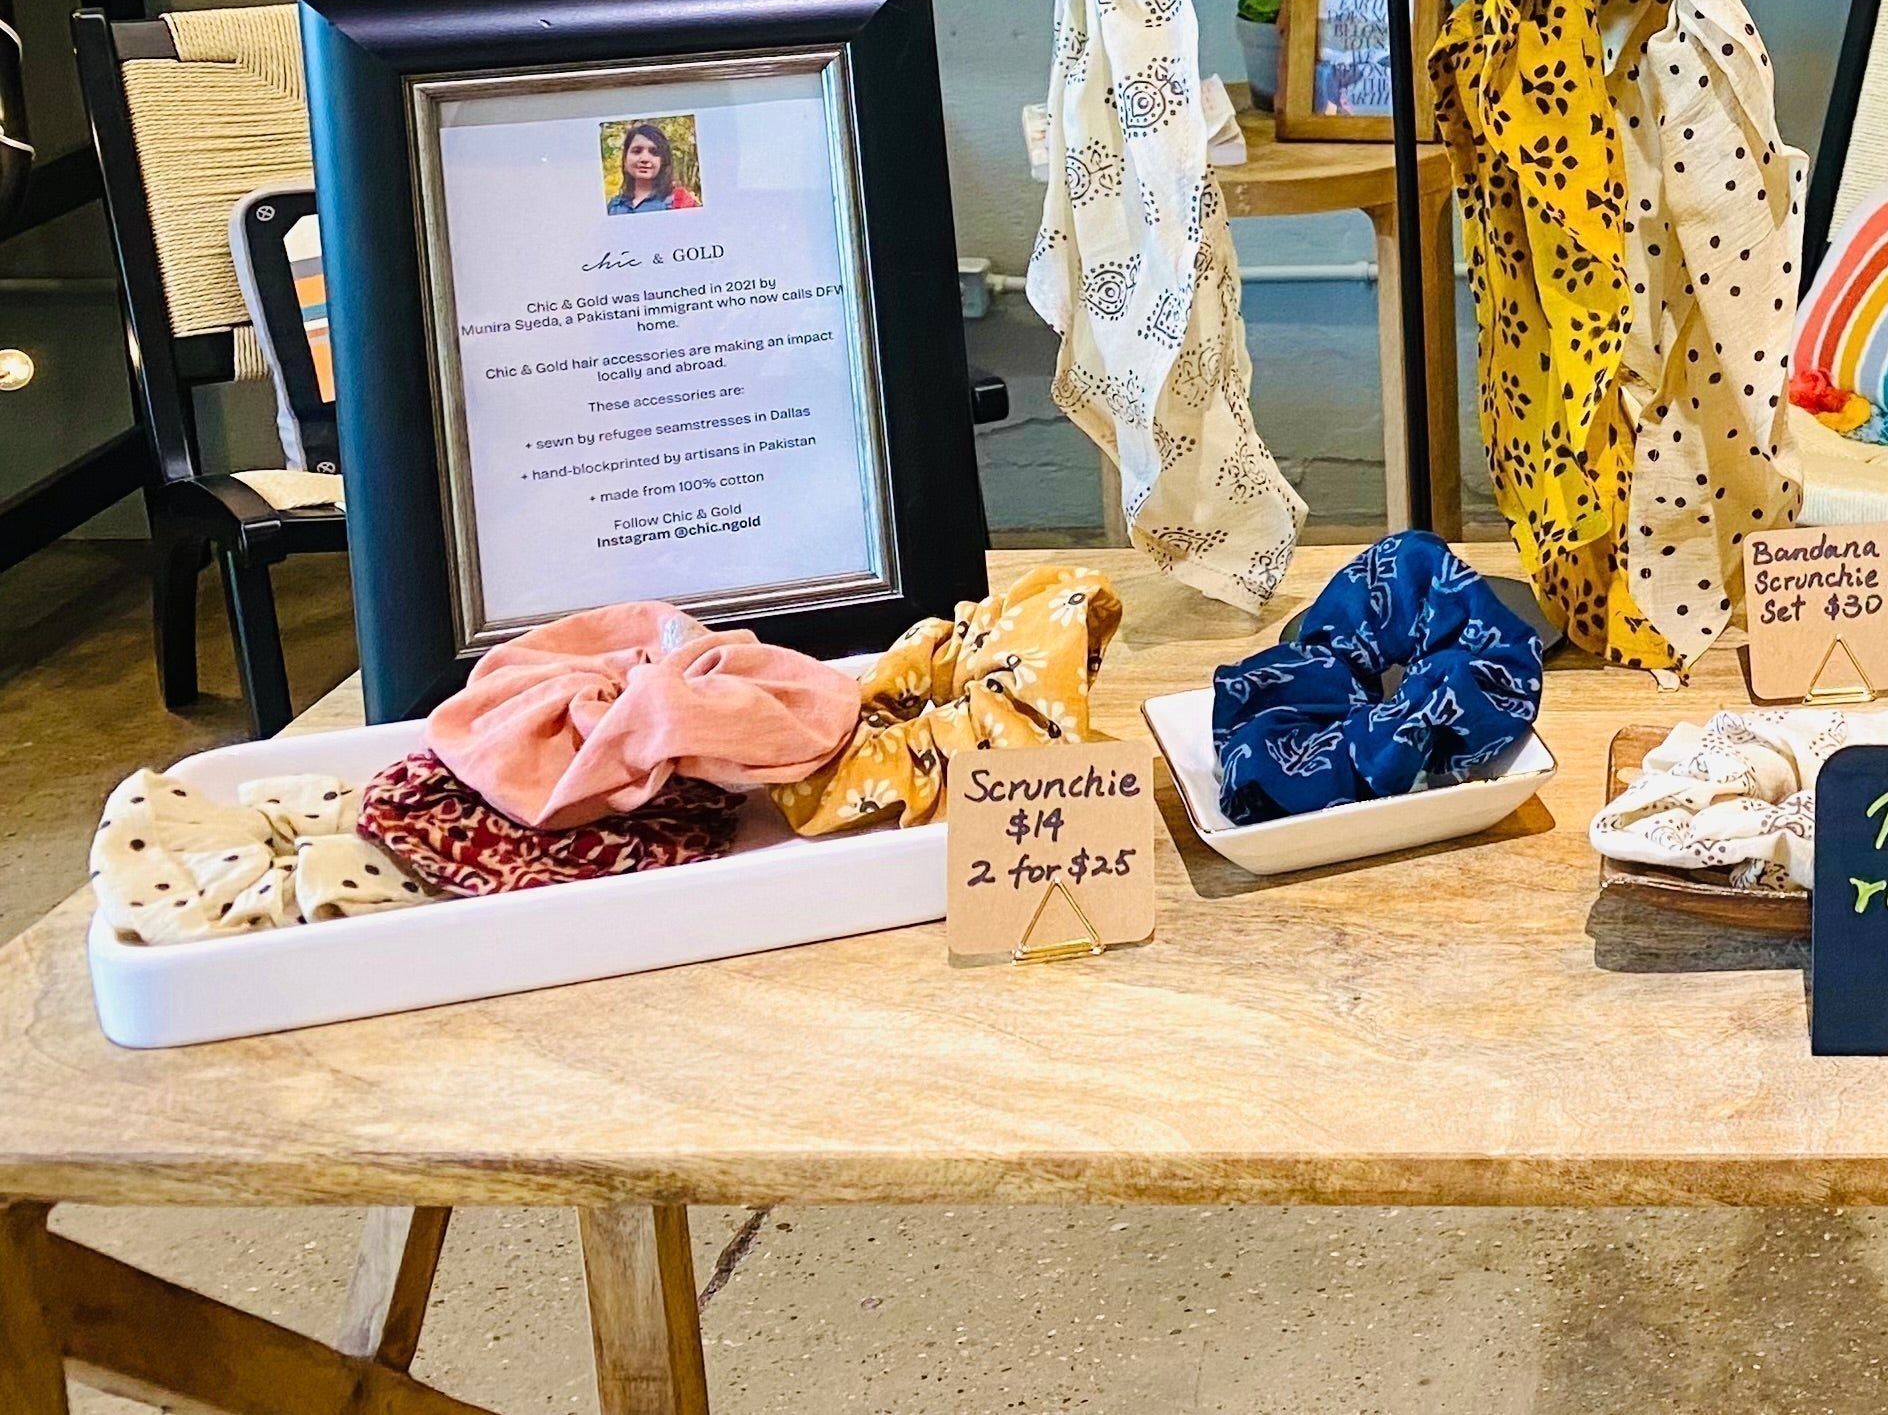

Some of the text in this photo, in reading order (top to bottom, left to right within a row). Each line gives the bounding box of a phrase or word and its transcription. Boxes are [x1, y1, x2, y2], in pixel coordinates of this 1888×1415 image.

[653, 253, 664, 264] &
[673, 245, 724, 262] GOLD
[461, 321, 511, 336] Munira
[515, 315, 562, 332] Syeda,
[565, 315, 574, 325] a
[577, 305, 640, 324] Pakistani
[643, 298, 714, 316] immigrant
[717, 295, 746, 308] who
[749, 292, 778, 304] now
[782, 288, 813, 301] calls
[527, 277, 776, 314] Chic & Gold was launched in 2021 by
[637, 318, 679, 332] home.
[485, 331, 834, 380] Chic & Gold hair accessories are making an impact
[597, 357, 727, 382] locally and abroad.
[588, 386, 745, 412] These accessories are:
[536, 407, 811, 450] sewn by refugee seamstresses in Dallas
[532, 435, 816, 481] hand-blockprinted by artisans in Pakistan
[600, 472, 764, 502] made from 100% cotton
[597, 515, 761, 548] Instagram @chic.ngold
[614, 503, 742, 531] Follow Chic & Gold
[1752, 533, 1881, 567] Bandana
[1755, 564, 1880, 595] Scrunchie
[1761, 593, 1883, 624] Set $30
[964, 765, 1141, 803] Scrunchie
[1006, 807, 1065, 845] $14
[967, 847, 1136, 889] 2 for $25
